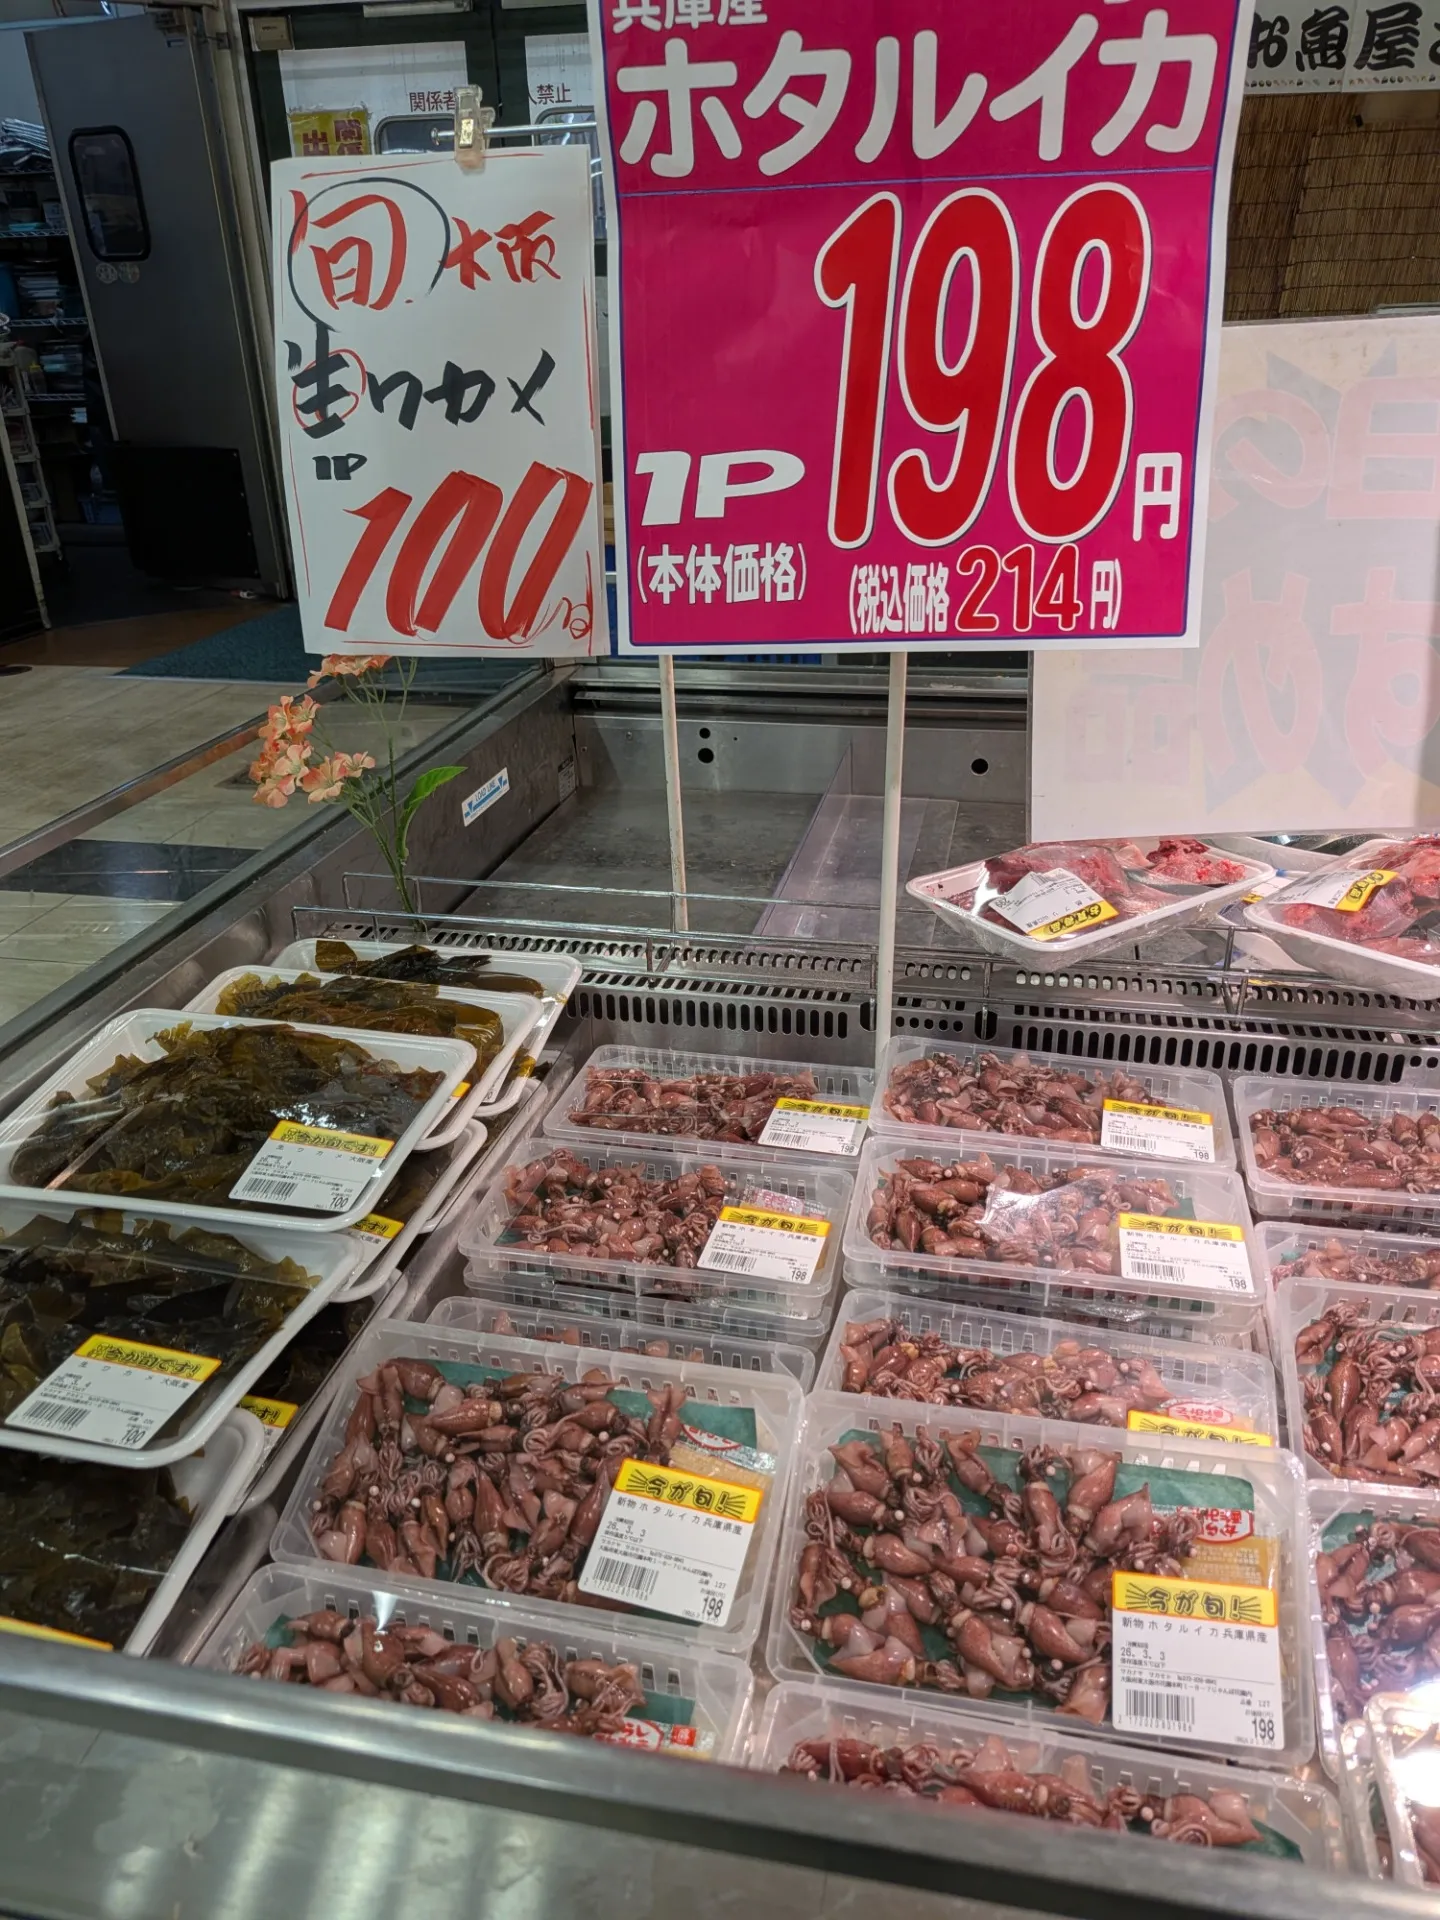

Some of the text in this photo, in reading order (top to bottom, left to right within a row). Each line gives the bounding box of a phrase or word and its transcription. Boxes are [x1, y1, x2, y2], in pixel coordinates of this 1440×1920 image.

[1247, 1, 1440, 72] お魚屋
[616, 8, 1219, 177] ホタルイカ
[289, 190, 562, 310] 旬 大阪
[284, 322, 556, 439] 生ワカメ
[635, 449, 806, 527] 1P
[637, 541, 807, 606] (本体価格)
[329, 1196, 349, 1208] 100
[790, 1269, 808, 1282] 198
[1229, 1278, 1248, 1290] 198
[122, 1428, 147, 1445] 100
[645, 1474, 728, 1514] 今が旬!
[701, 1596, 724, 1619] 198
[1146, 1587, 1242, 1621] 今が旬!
[1251, 1717, 1276, 1740] 198
